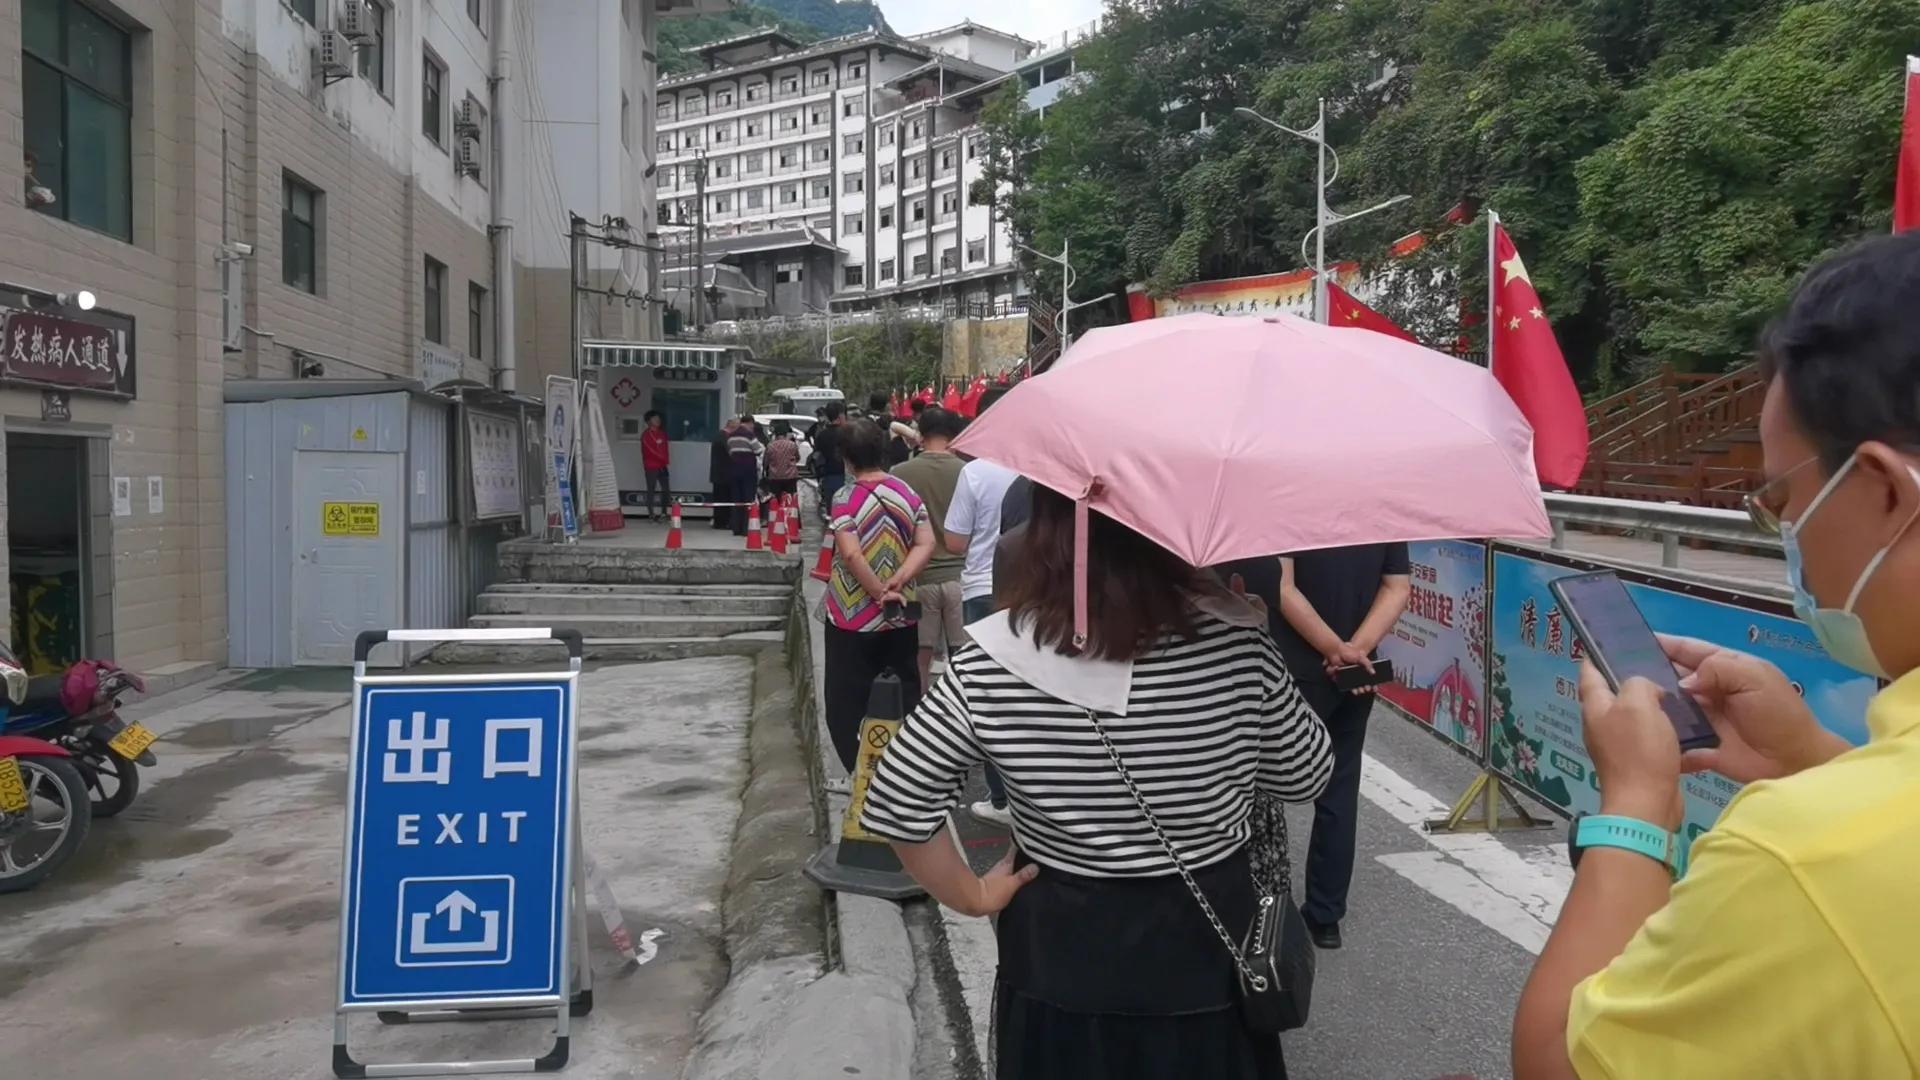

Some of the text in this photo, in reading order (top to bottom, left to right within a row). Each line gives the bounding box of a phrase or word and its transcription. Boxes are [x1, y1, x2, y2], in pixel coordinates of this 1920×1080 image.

[11, 323, 112, 372] 发热病人通道
[383, 711, 543, 784] 出口
[397, 811, 528, 846] EXIT
